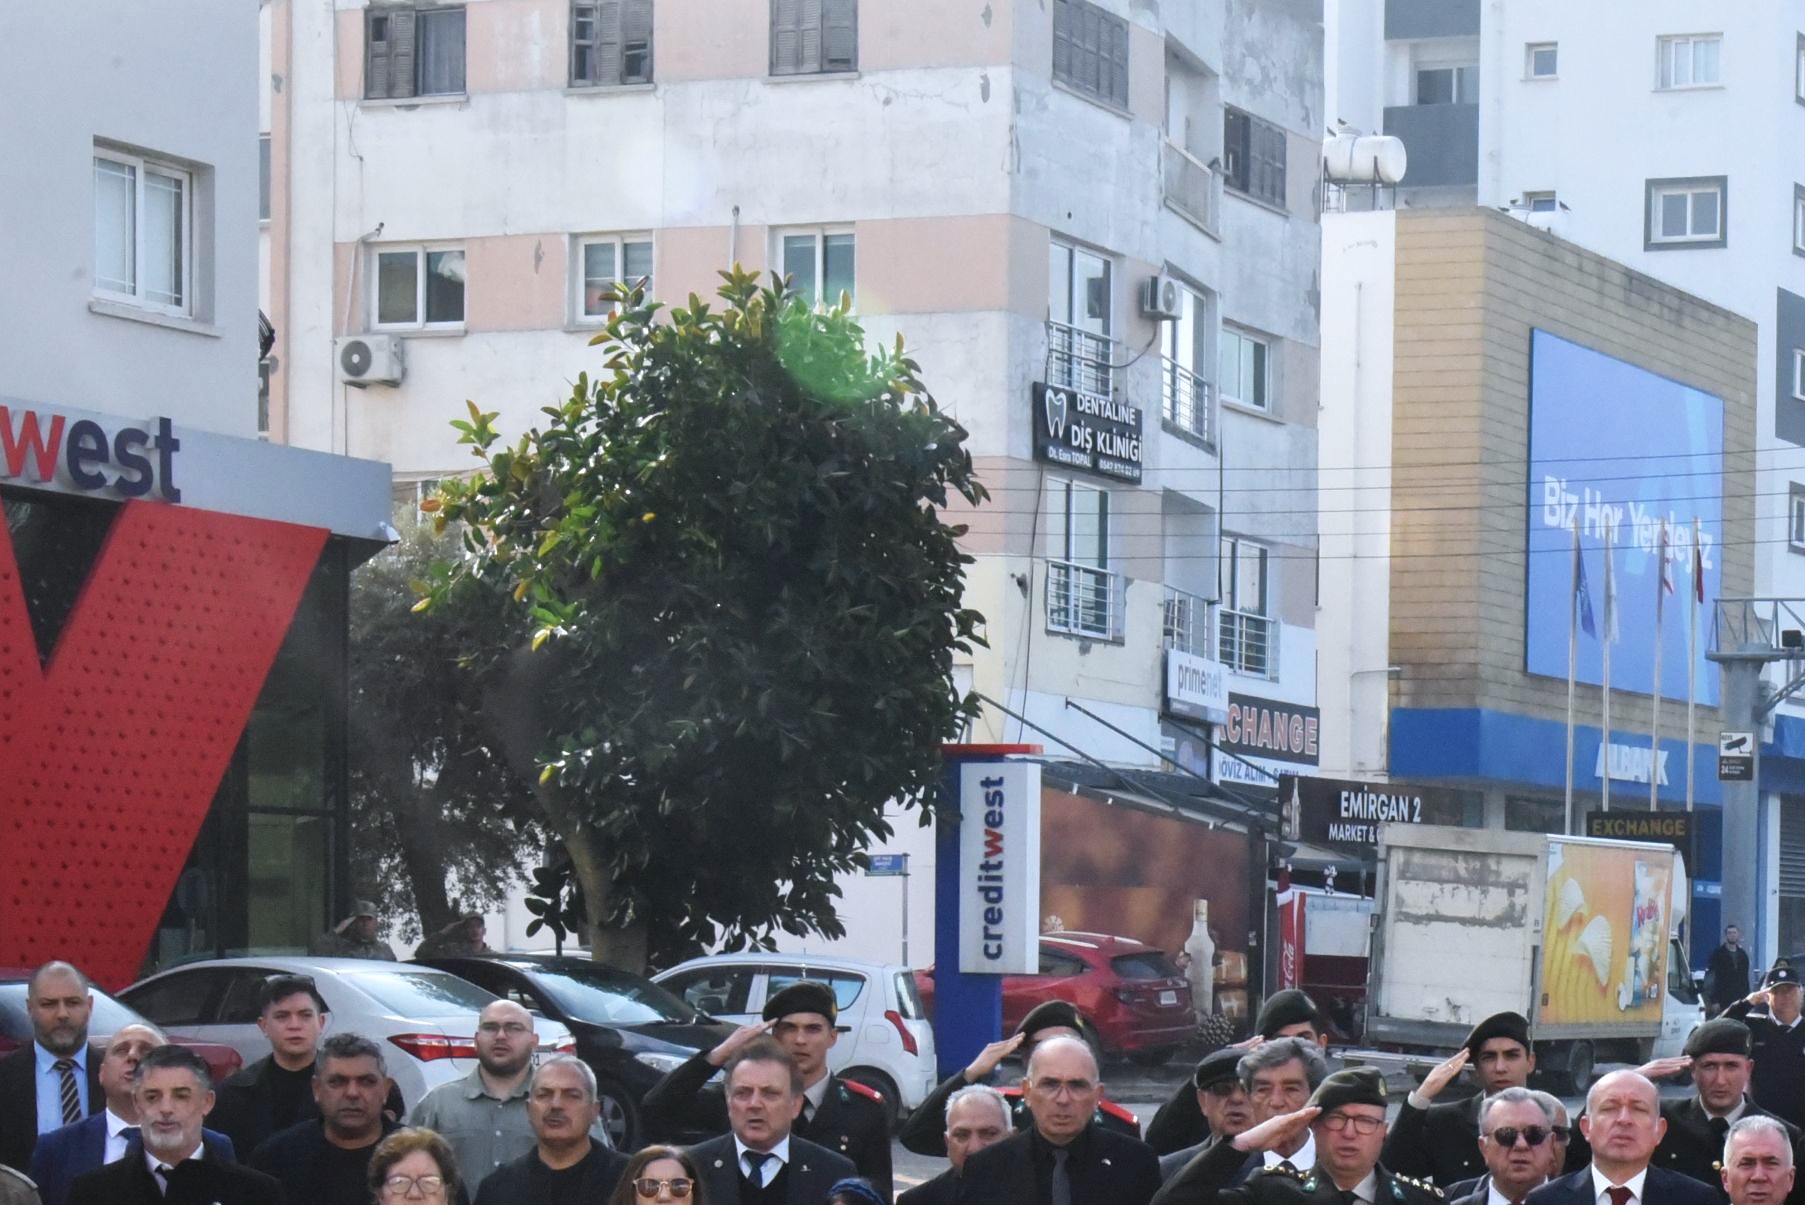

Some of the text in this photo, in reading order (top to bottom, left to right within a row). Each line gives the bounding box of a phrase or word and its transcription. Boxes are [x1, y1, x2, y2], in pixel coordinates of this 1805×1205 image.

[1077, 394, 1136, 426] DENTALINE
[1071, 420, 1142, 463] DİŞ KLİNİĞİ
[1544, 475, 1579, 532] Biz
[1178, 658, 1223, 699] primenet
[1219, 703, 1319, 756] CHANGE
[1219, 757, 1242, 779] ÖVİZ
[1340, 785, 1422, 823] EMİRGAN 2
[1328, 823, 1367, 843] MARKET
[1592, 818, 1686, 836] EXCHANGE
[977, 776, 1005, 960] creditwest
